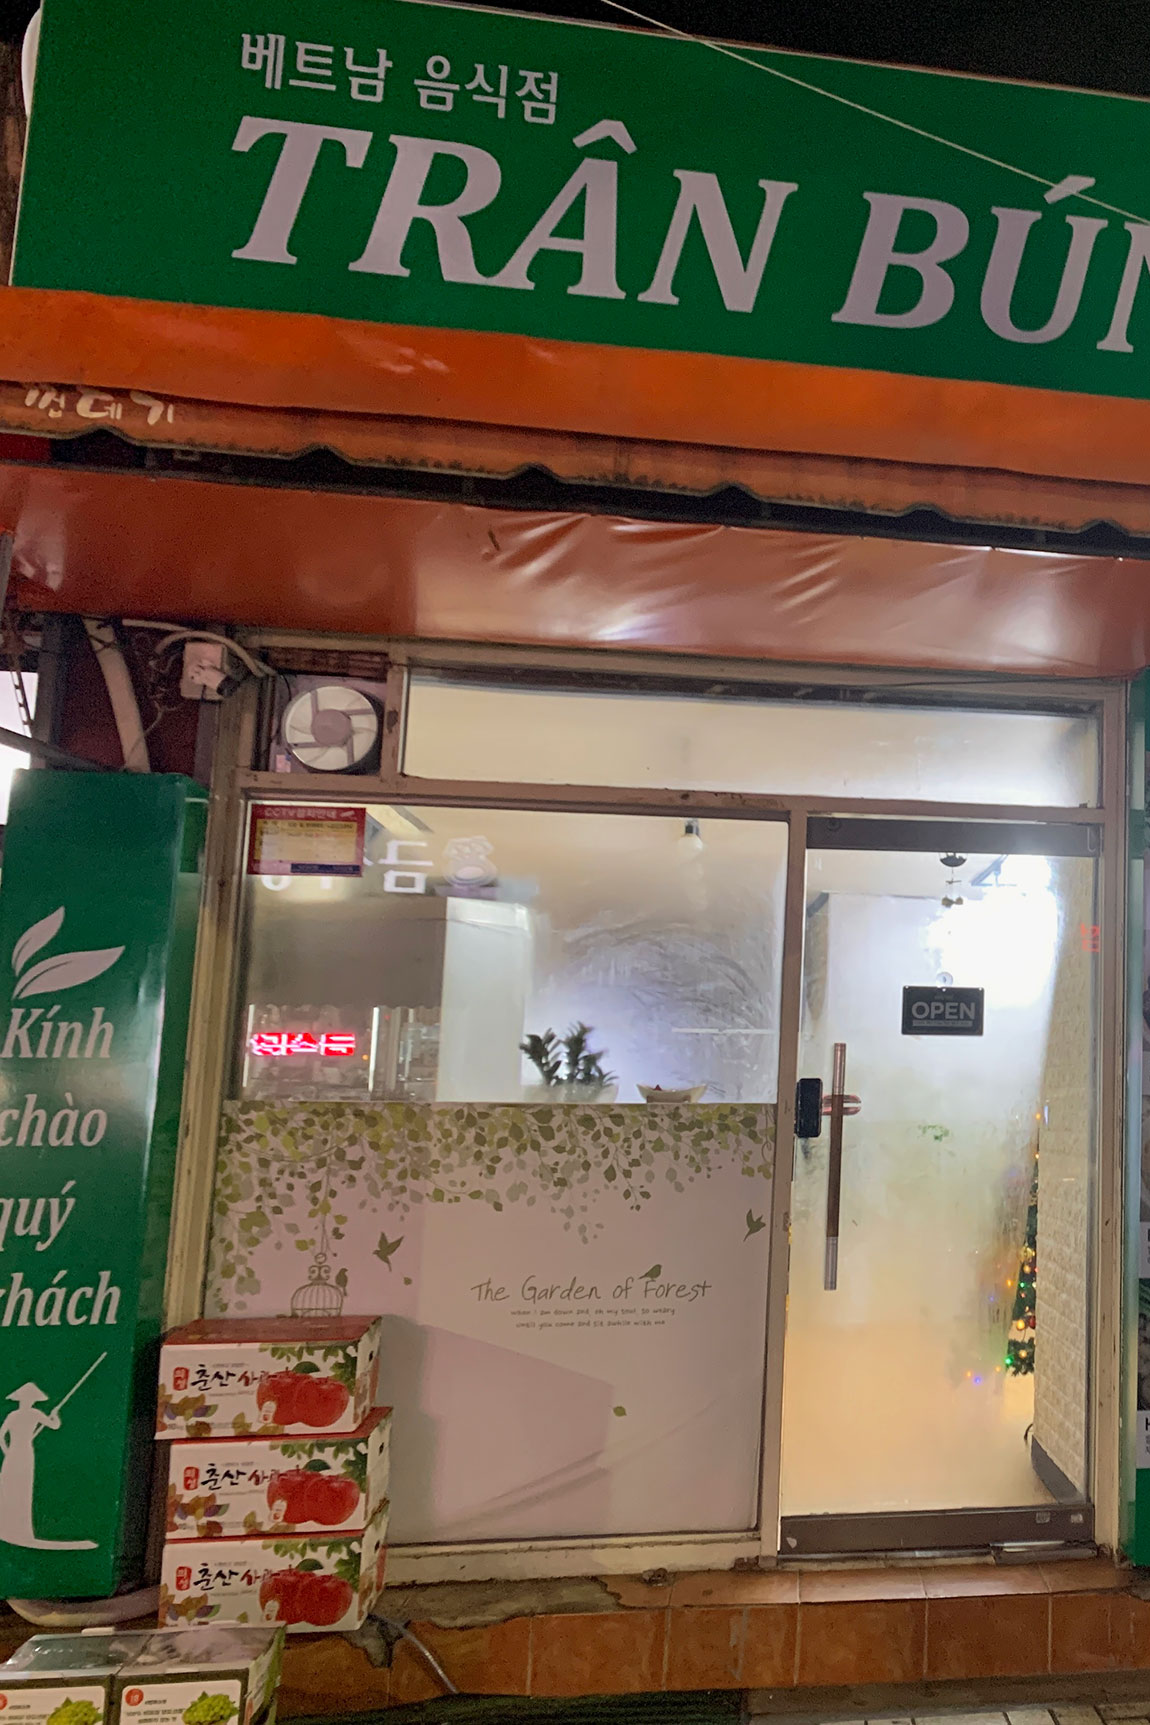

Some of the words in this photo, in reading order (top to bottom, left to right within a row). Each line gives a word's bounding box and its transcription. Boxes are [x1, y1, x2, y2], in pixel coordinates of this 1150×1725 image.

[240, 33, 393, 102] 베트남
[413, 54, 559, 126] 음식점
[231, 115, 798, 313] TRÂN
[0, 1004, 114, 1059] Kính
[911, 1001, 976, 1020] OPEN
[0, 1269, 121, 1327] hách
[470, 1277, 510, 1302] The
[521, 1274, 601, 1304] Garden
[612, 1276, 635, 1300] of
[643, 1279, 712, 1302] Forest
